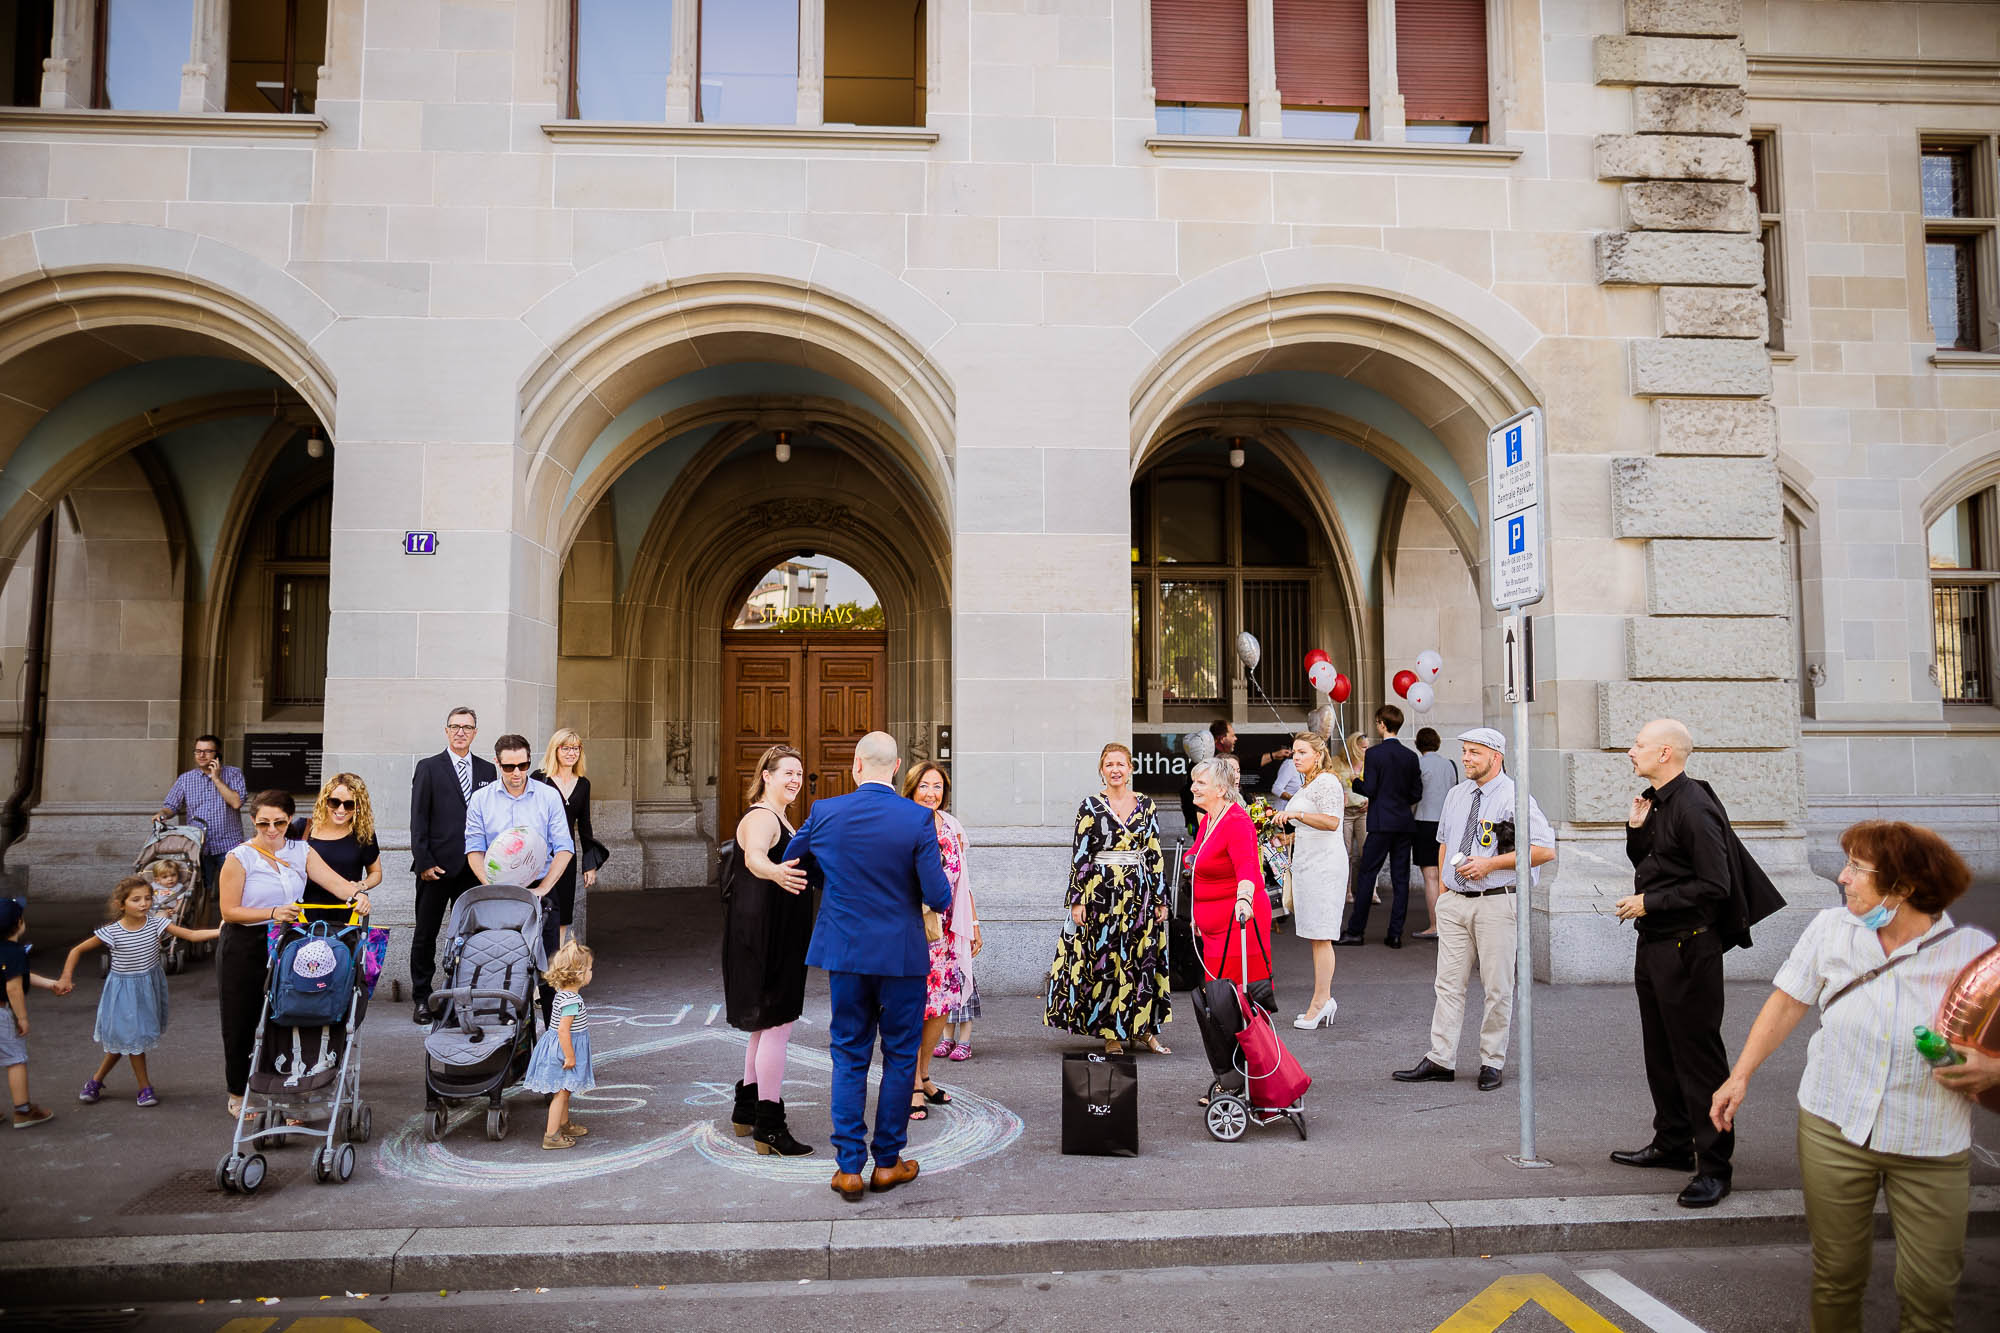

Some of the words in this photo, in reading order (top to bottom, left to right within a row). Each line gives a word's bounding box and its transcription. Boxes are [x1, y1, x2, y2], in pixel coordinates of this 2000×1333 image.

[411, 534, 429, 551] 17
[1513, 523, 1521, 550] P
[759, 607, 853, 625] STADTHAVS
[1132, 752, 1192, 775] dtha
